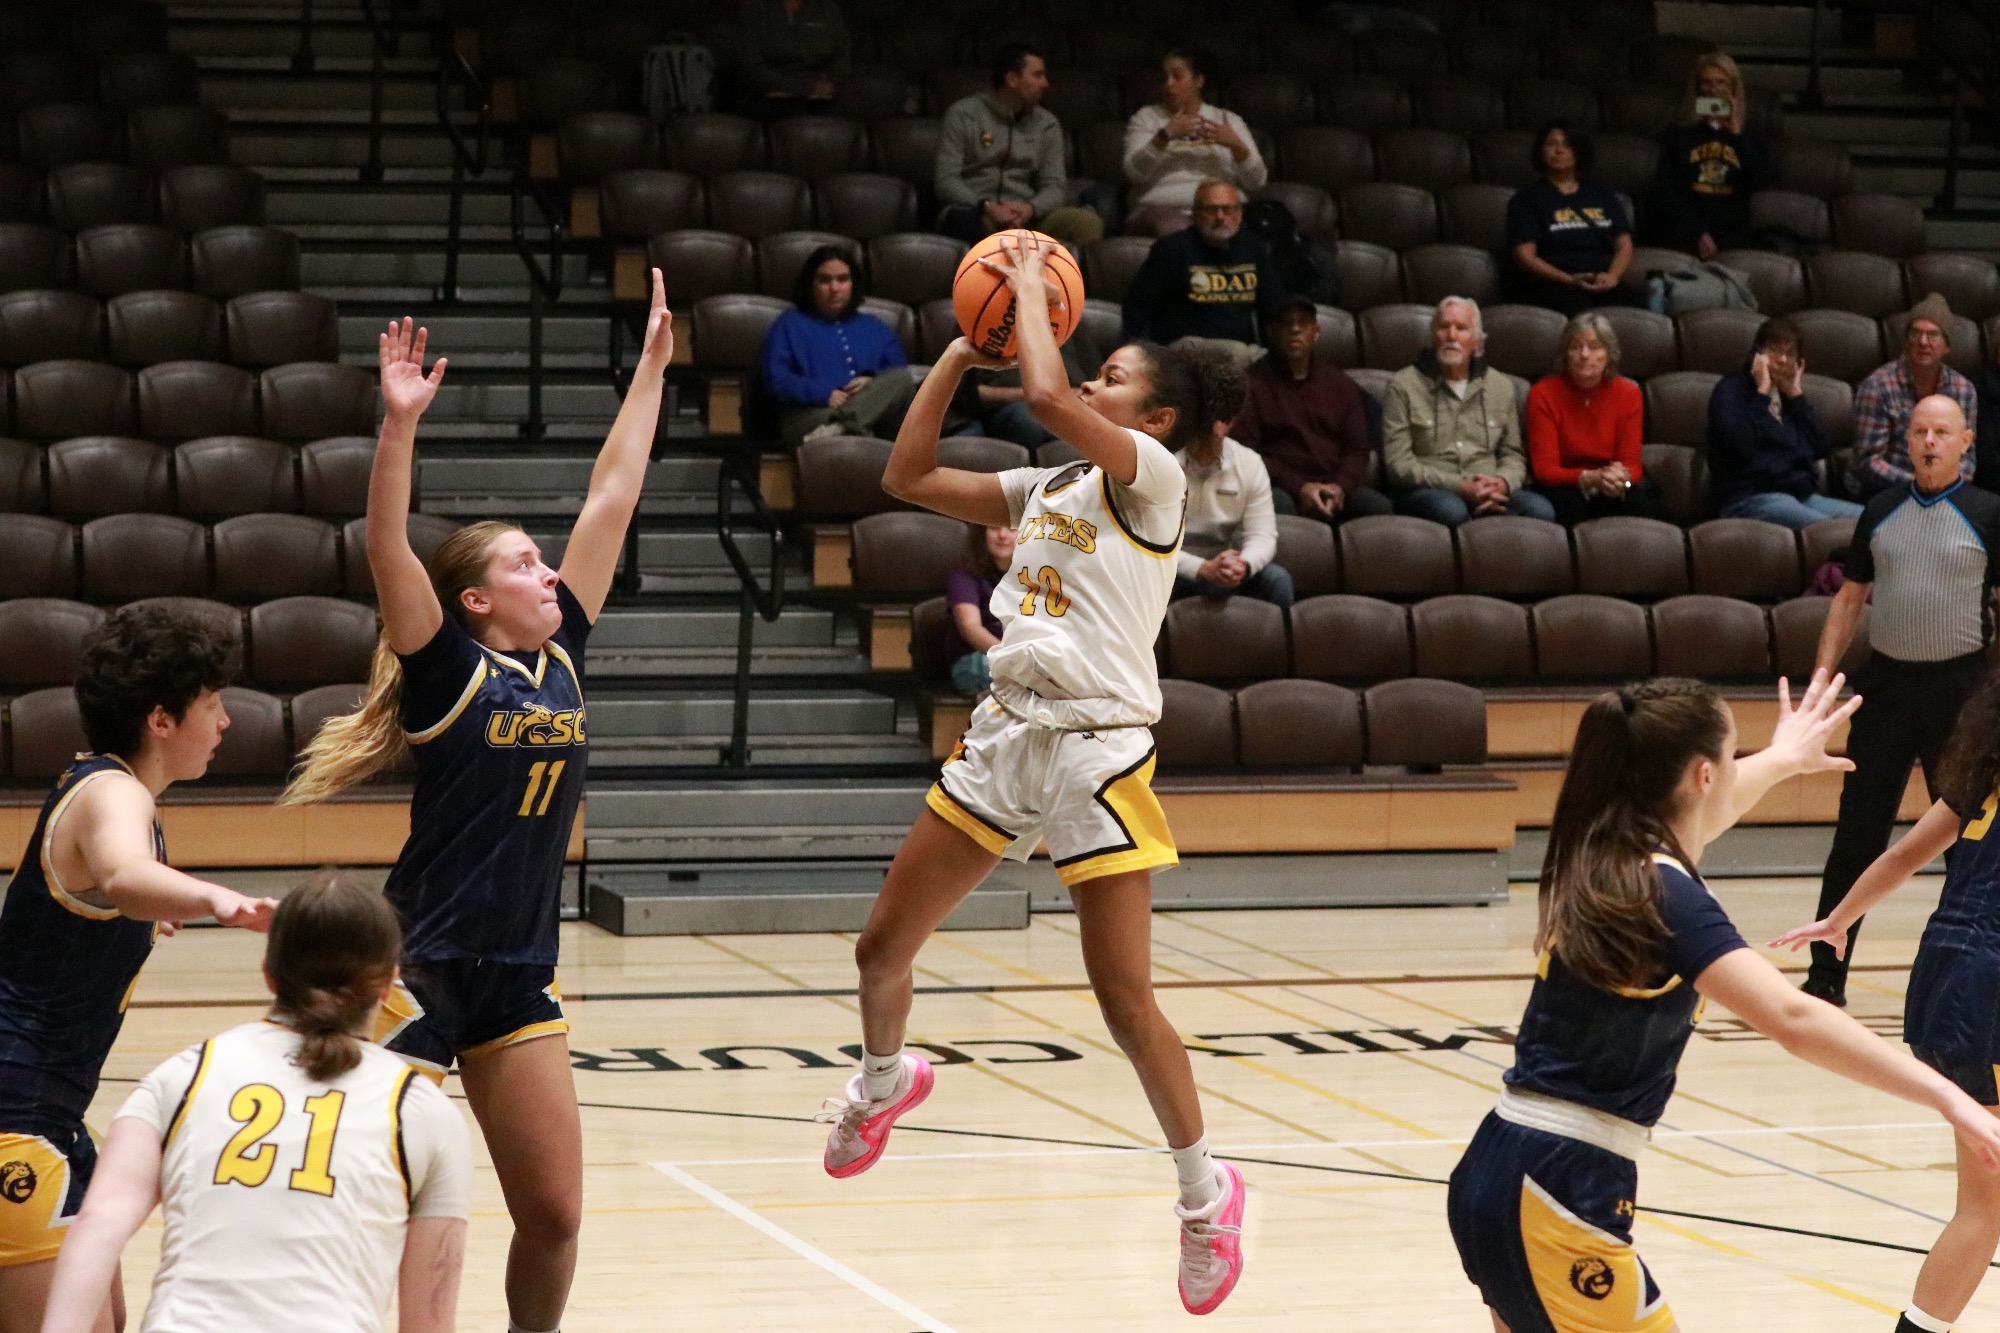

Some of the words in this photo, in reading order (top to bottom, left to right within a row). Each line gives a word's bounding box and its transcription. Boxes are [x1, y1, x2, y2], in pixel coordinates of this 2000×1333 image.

[1210, 272, 1258, 293] DAD
[1017, 511, 1098, 555] UTES
[517, 759, 568, 817] 11
[568, 1040, 1084, 1073] COUR
[212, 1082, 347, 1198] 21
